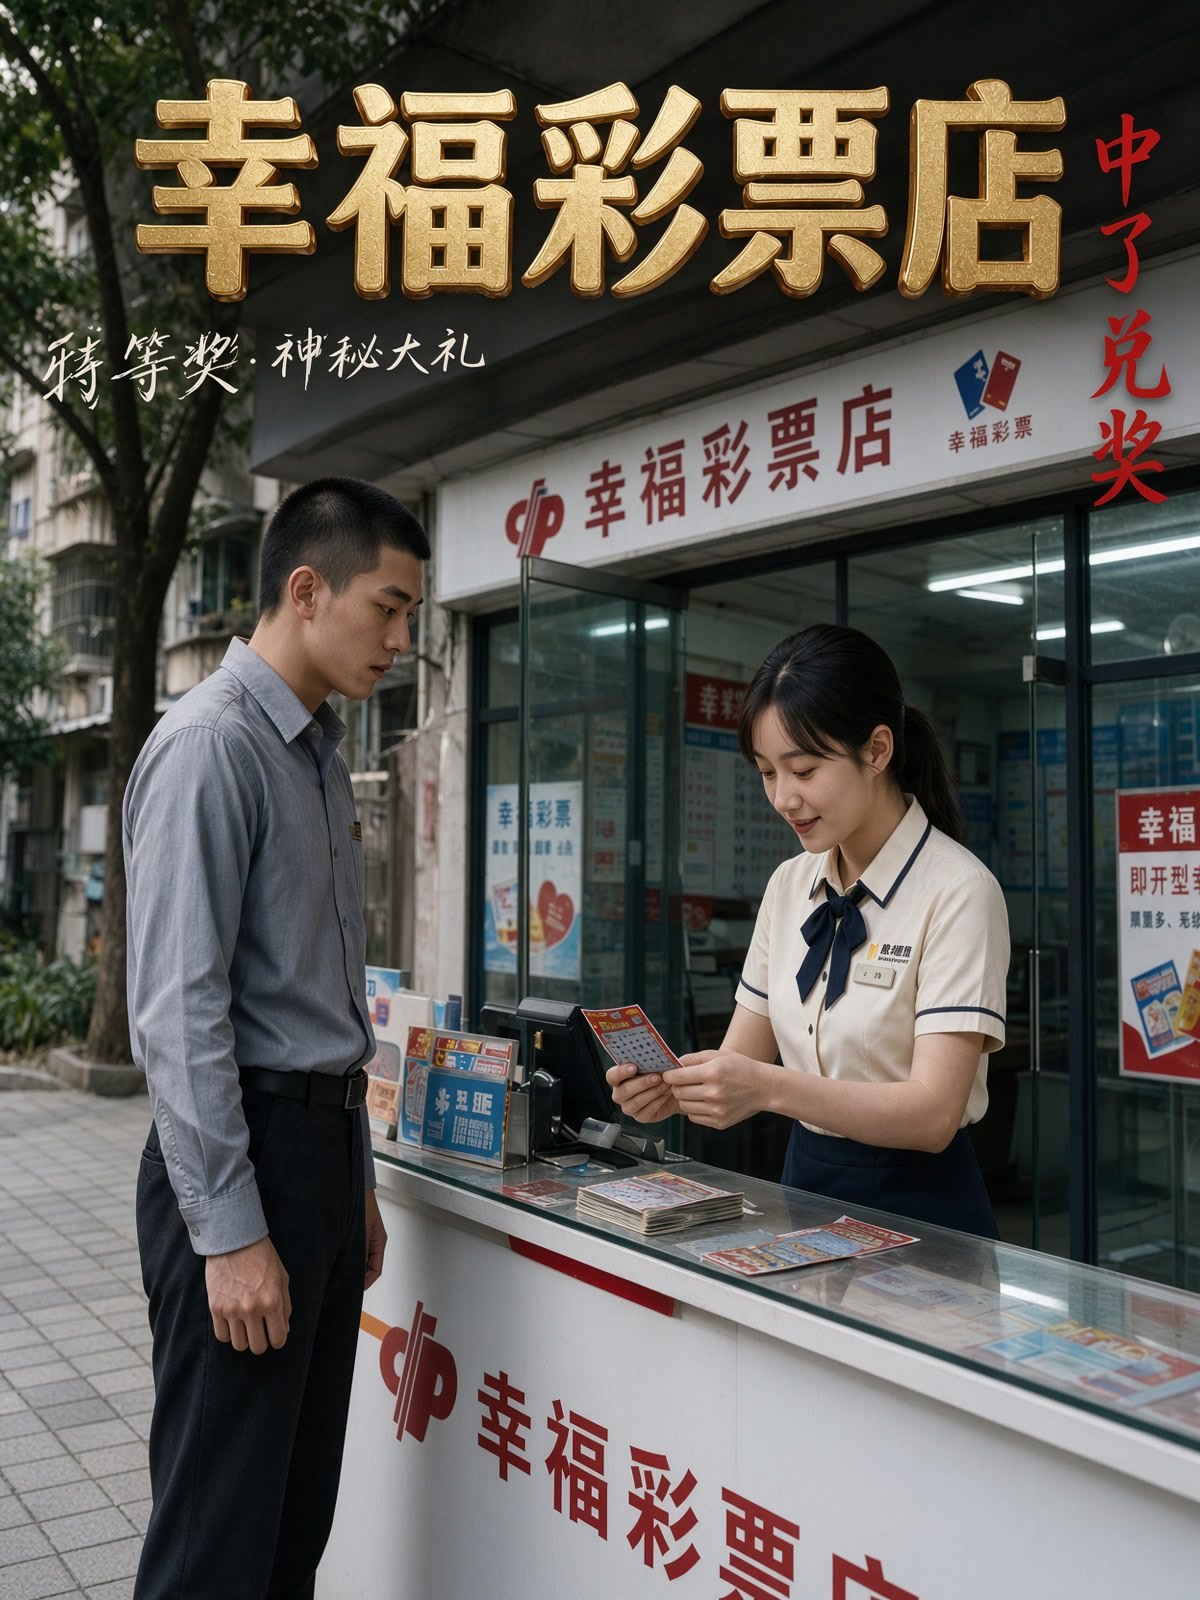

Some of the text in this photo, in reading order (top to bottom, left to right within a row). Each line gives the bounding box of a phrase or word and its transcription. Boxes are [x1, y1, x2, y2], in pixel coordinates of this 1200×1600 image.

[948, 415, 1033, 454] 幸福彩票
[585, 383, 893, 539] 幸福彩票店
[1138, 806, 1197, 846] 幸福
